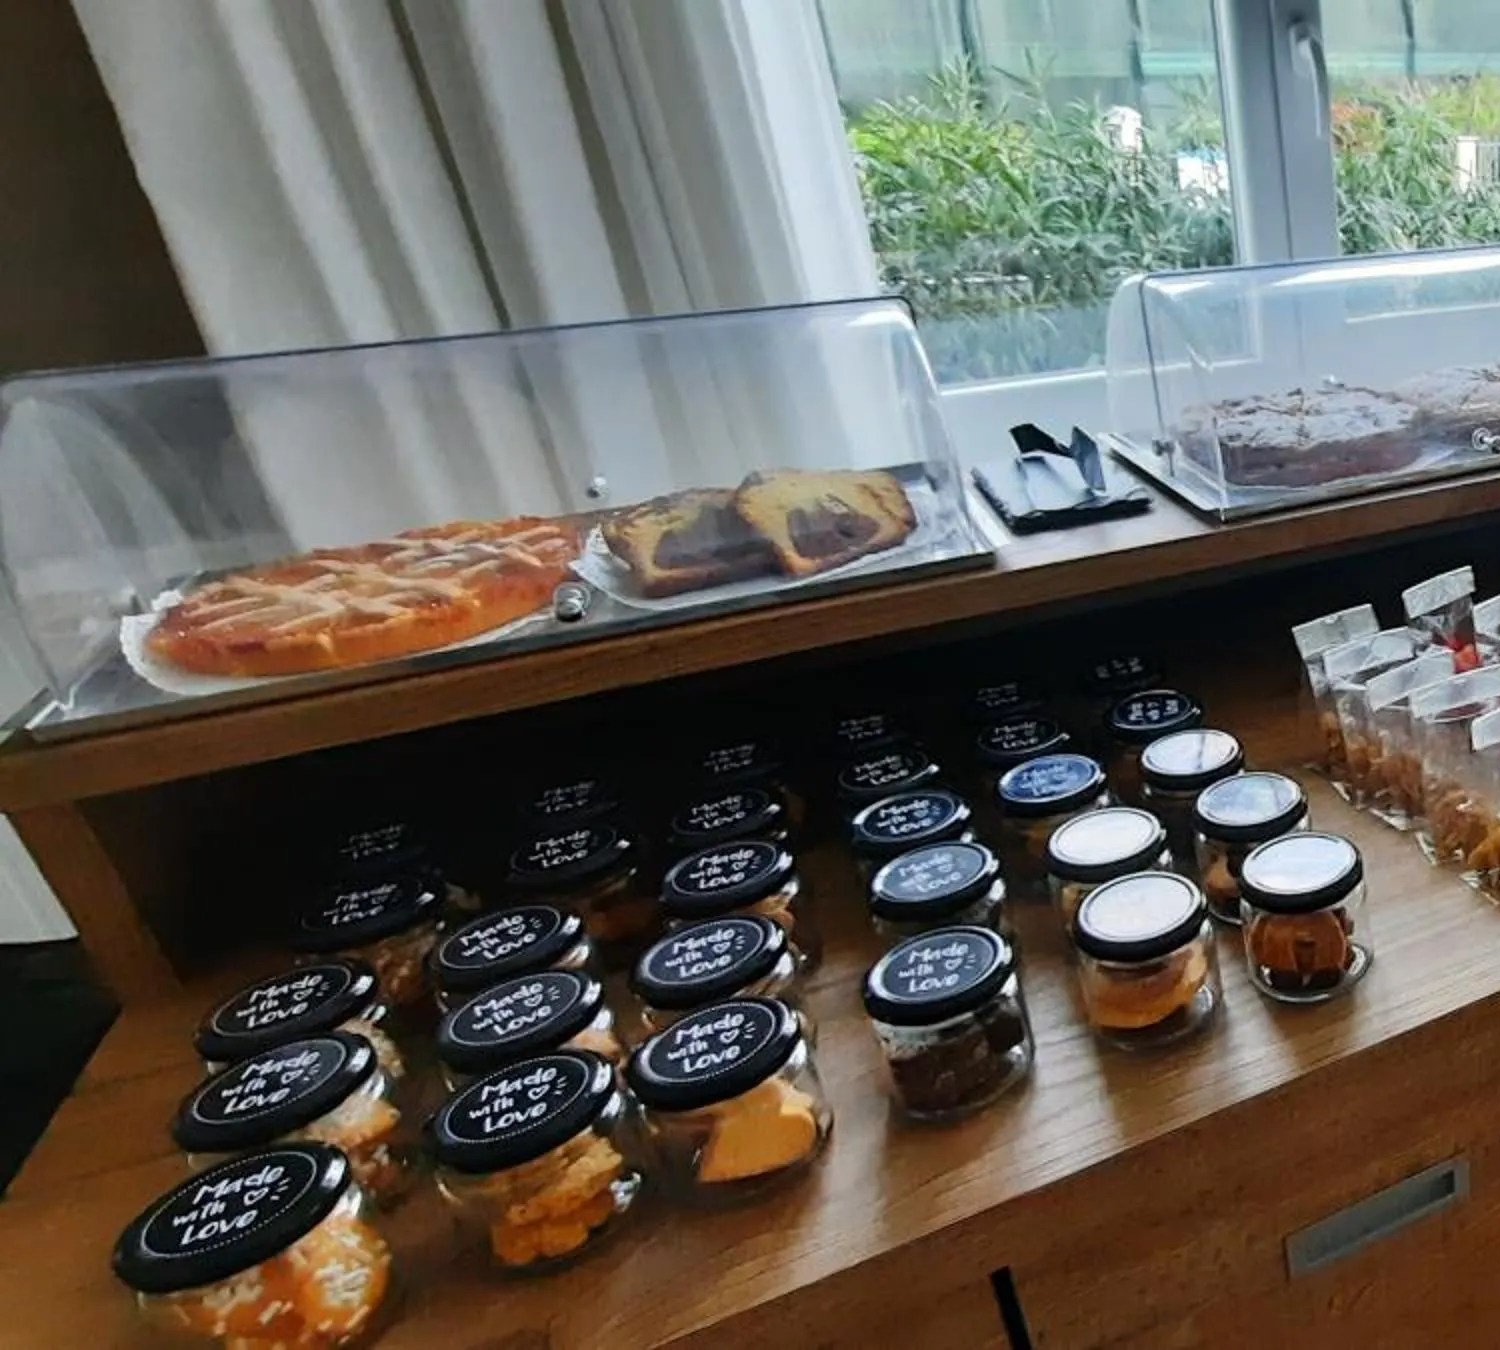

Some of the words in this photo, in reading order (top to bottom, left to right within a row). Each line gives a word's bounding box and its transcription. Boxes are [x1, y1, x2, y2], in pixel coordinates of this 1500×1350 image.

[698, 849, 754, 867] Made
[460, 915, 524, 946] Made
[671, 927, 736, 954] Made
[908, 942, 969, 963] Made
[250, 974, 323, 1003] Made
[473, 982, 544, 1016] Made
[675, 1012, 745, 1045] Made
[241, 1050, 321, 1080] Made
[480, 1067, 557, 1101] Made
[193, 1165, 285, 1205] Made
